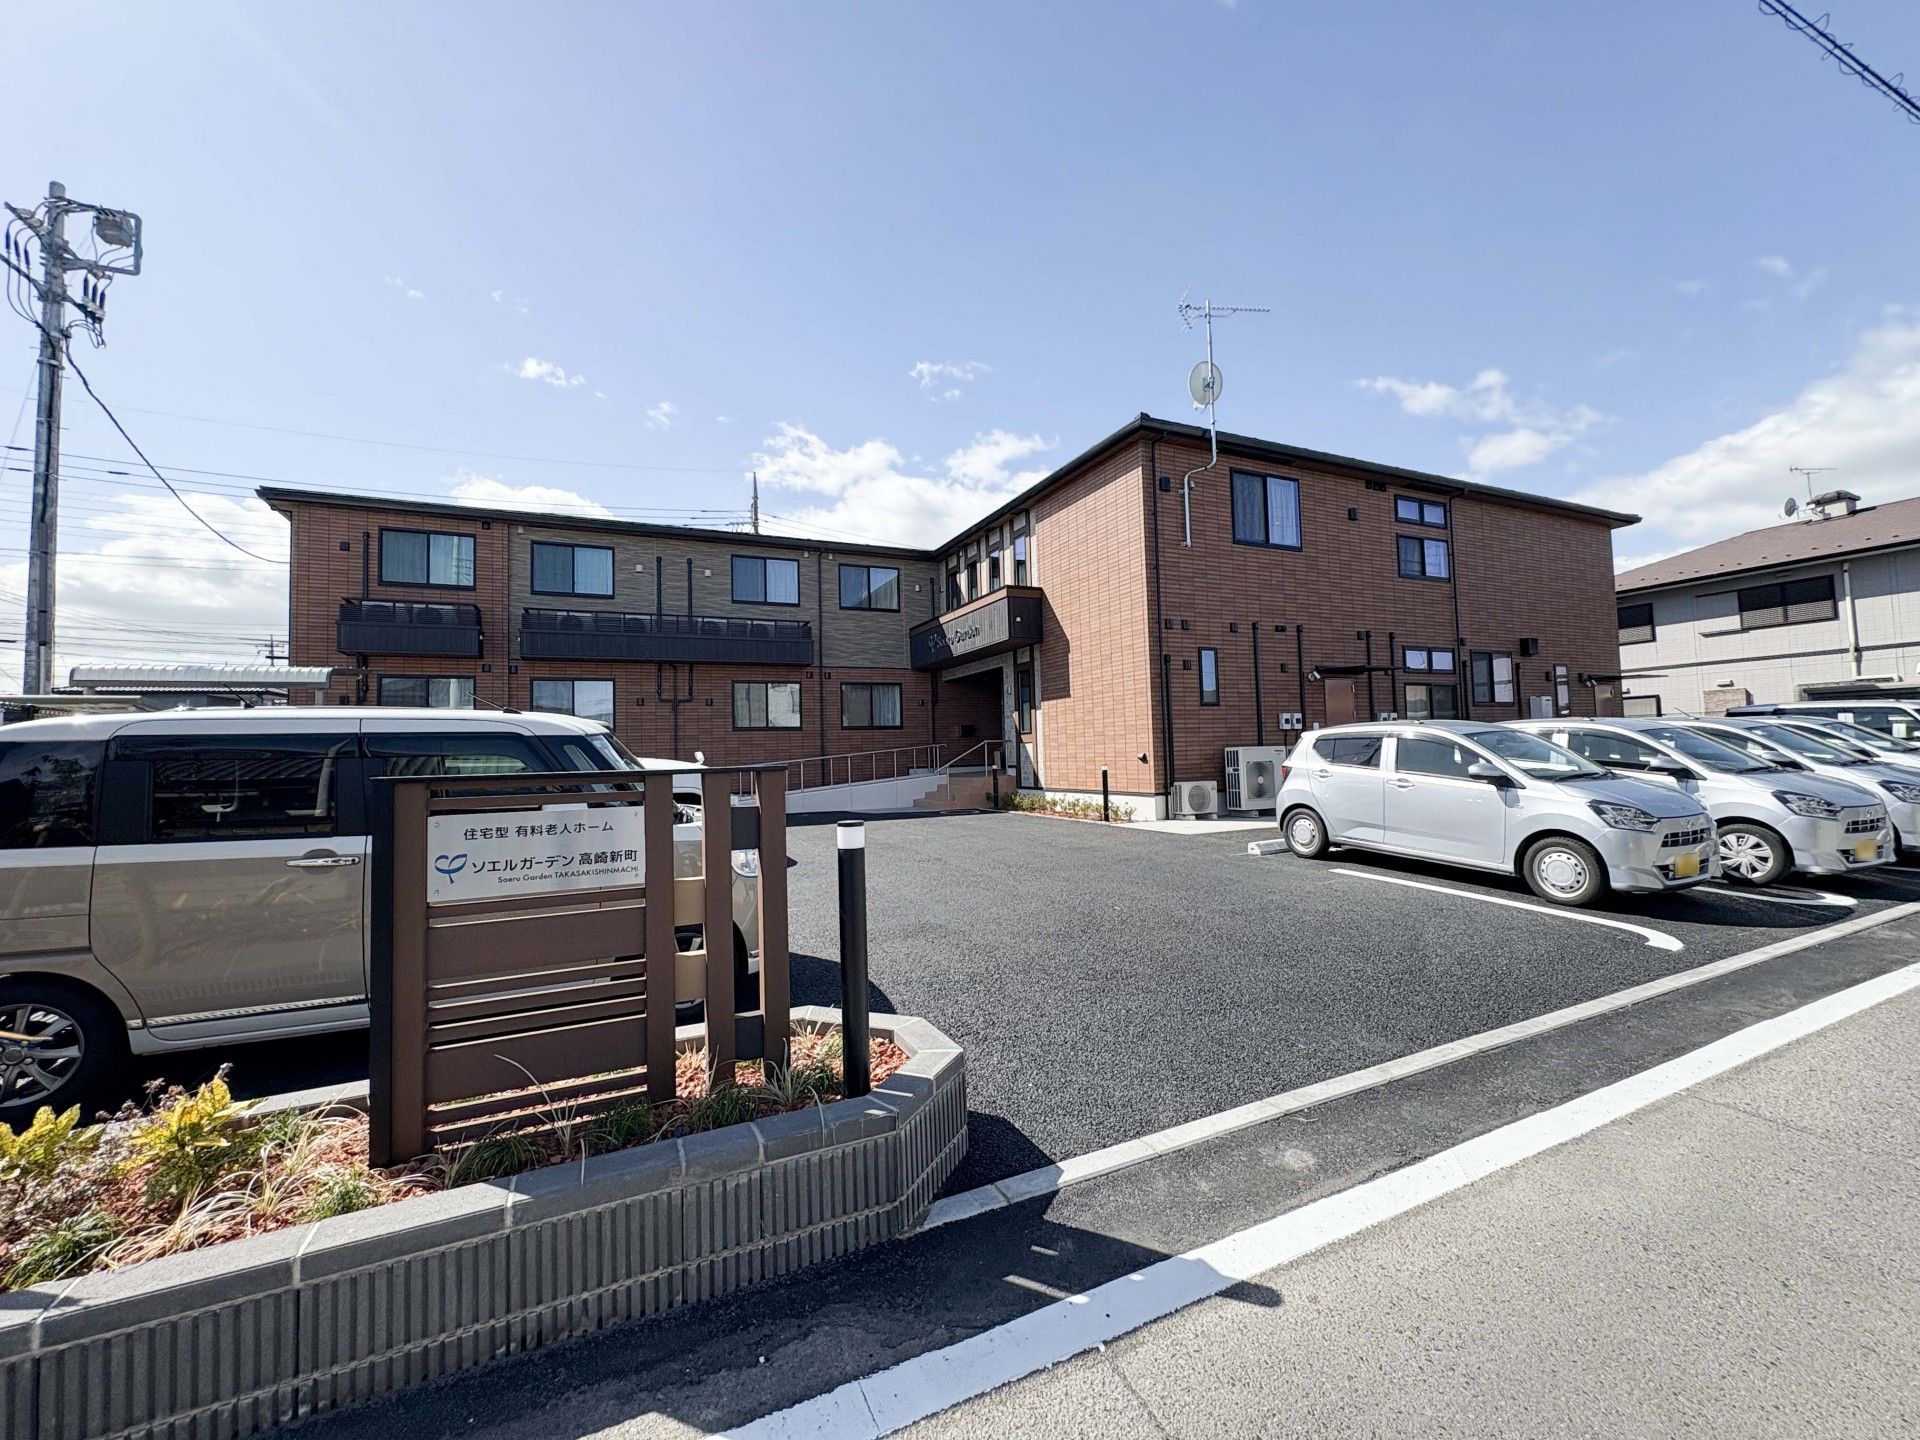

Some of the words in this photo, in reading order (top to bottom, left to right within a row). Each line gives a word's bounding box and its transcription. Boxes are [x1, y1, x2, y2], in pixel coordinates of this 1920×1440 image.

[463, 826, 509, 841] 住宅型
[515, 821, 614, 837] 有料老人ホーム
[472, 855, 575, 873] ソエルガーデン
[578, 850, 638, 866] 高崎新町
[523, 873, 553, 881] Garden
[554, 866, 639, 878] TAKASAKISHINMACHI
